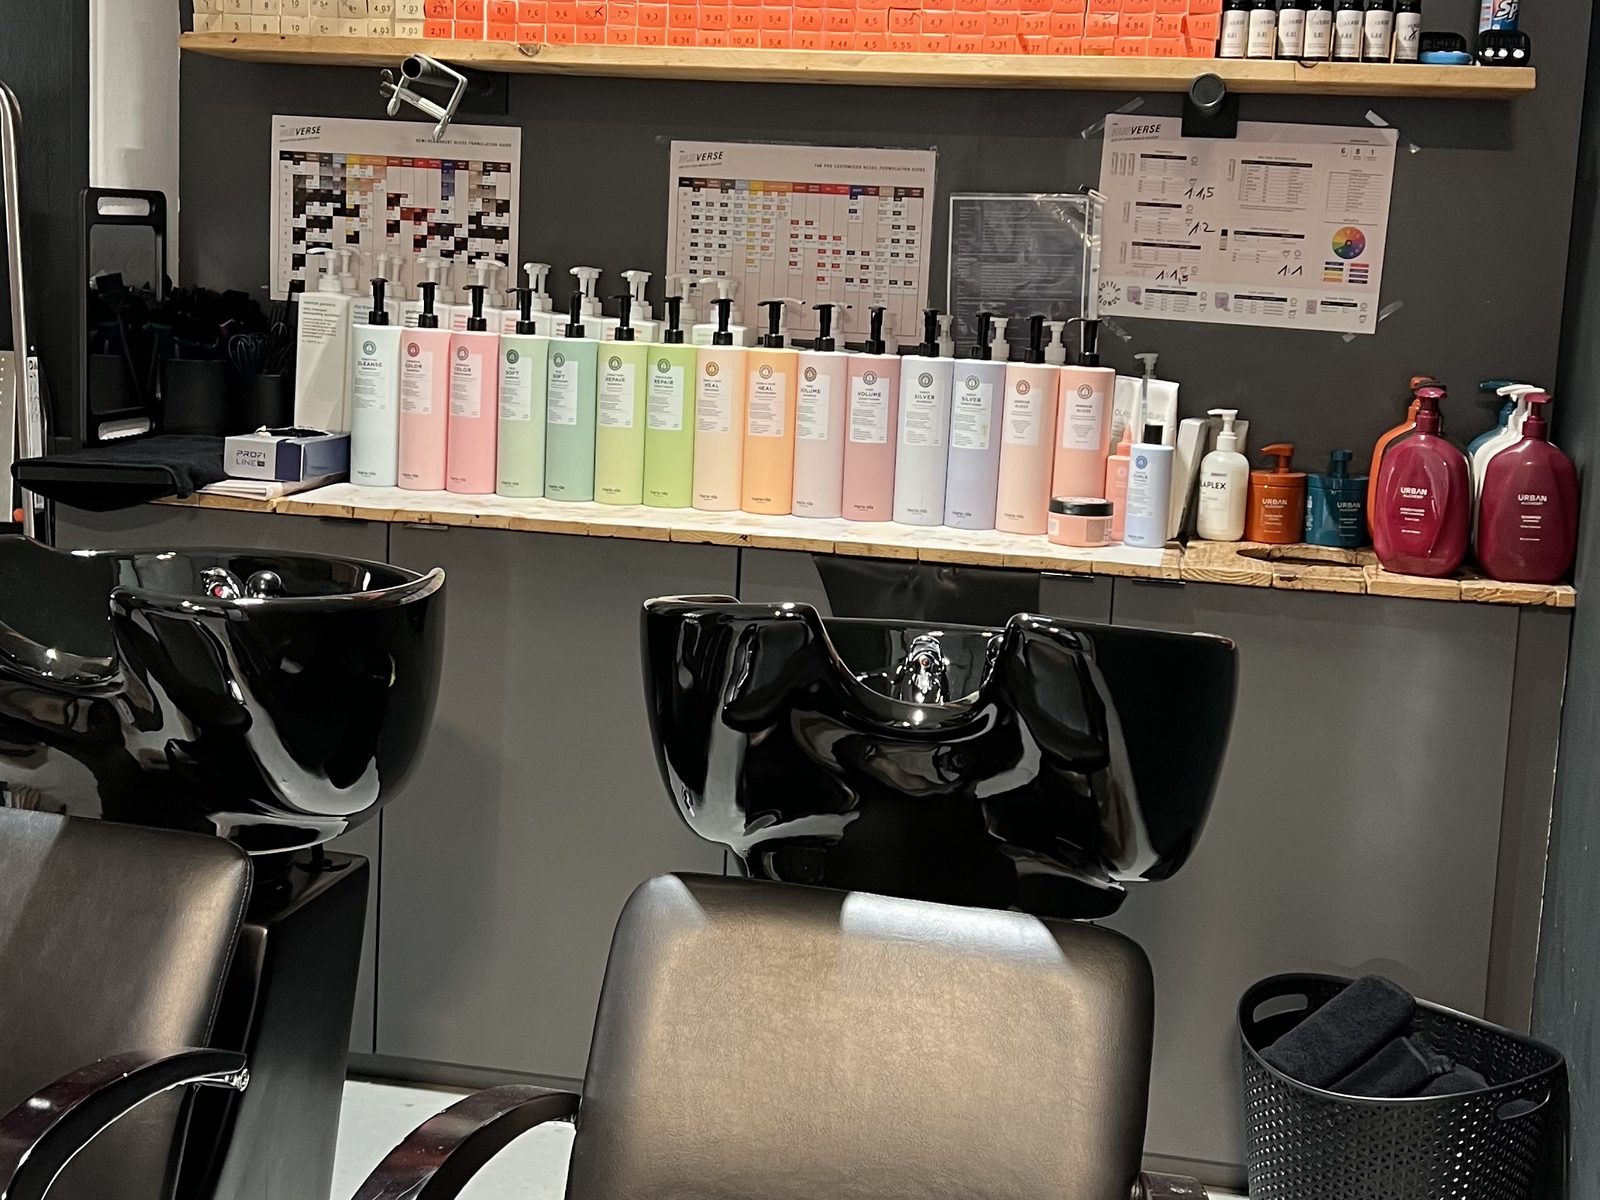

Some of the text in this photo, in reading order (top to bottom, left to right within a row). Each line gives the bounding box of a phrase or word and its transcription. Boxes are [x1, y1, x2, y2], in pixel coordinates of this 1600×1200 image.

[857, 390, 882, 398] VOLUME
[236, 449, 266, 459] PROFI
[236, 458, 257, 467] LINE
[1400, 486, 1428, 496] URBAN
[1517, 494, 1548, 502] URBAN
